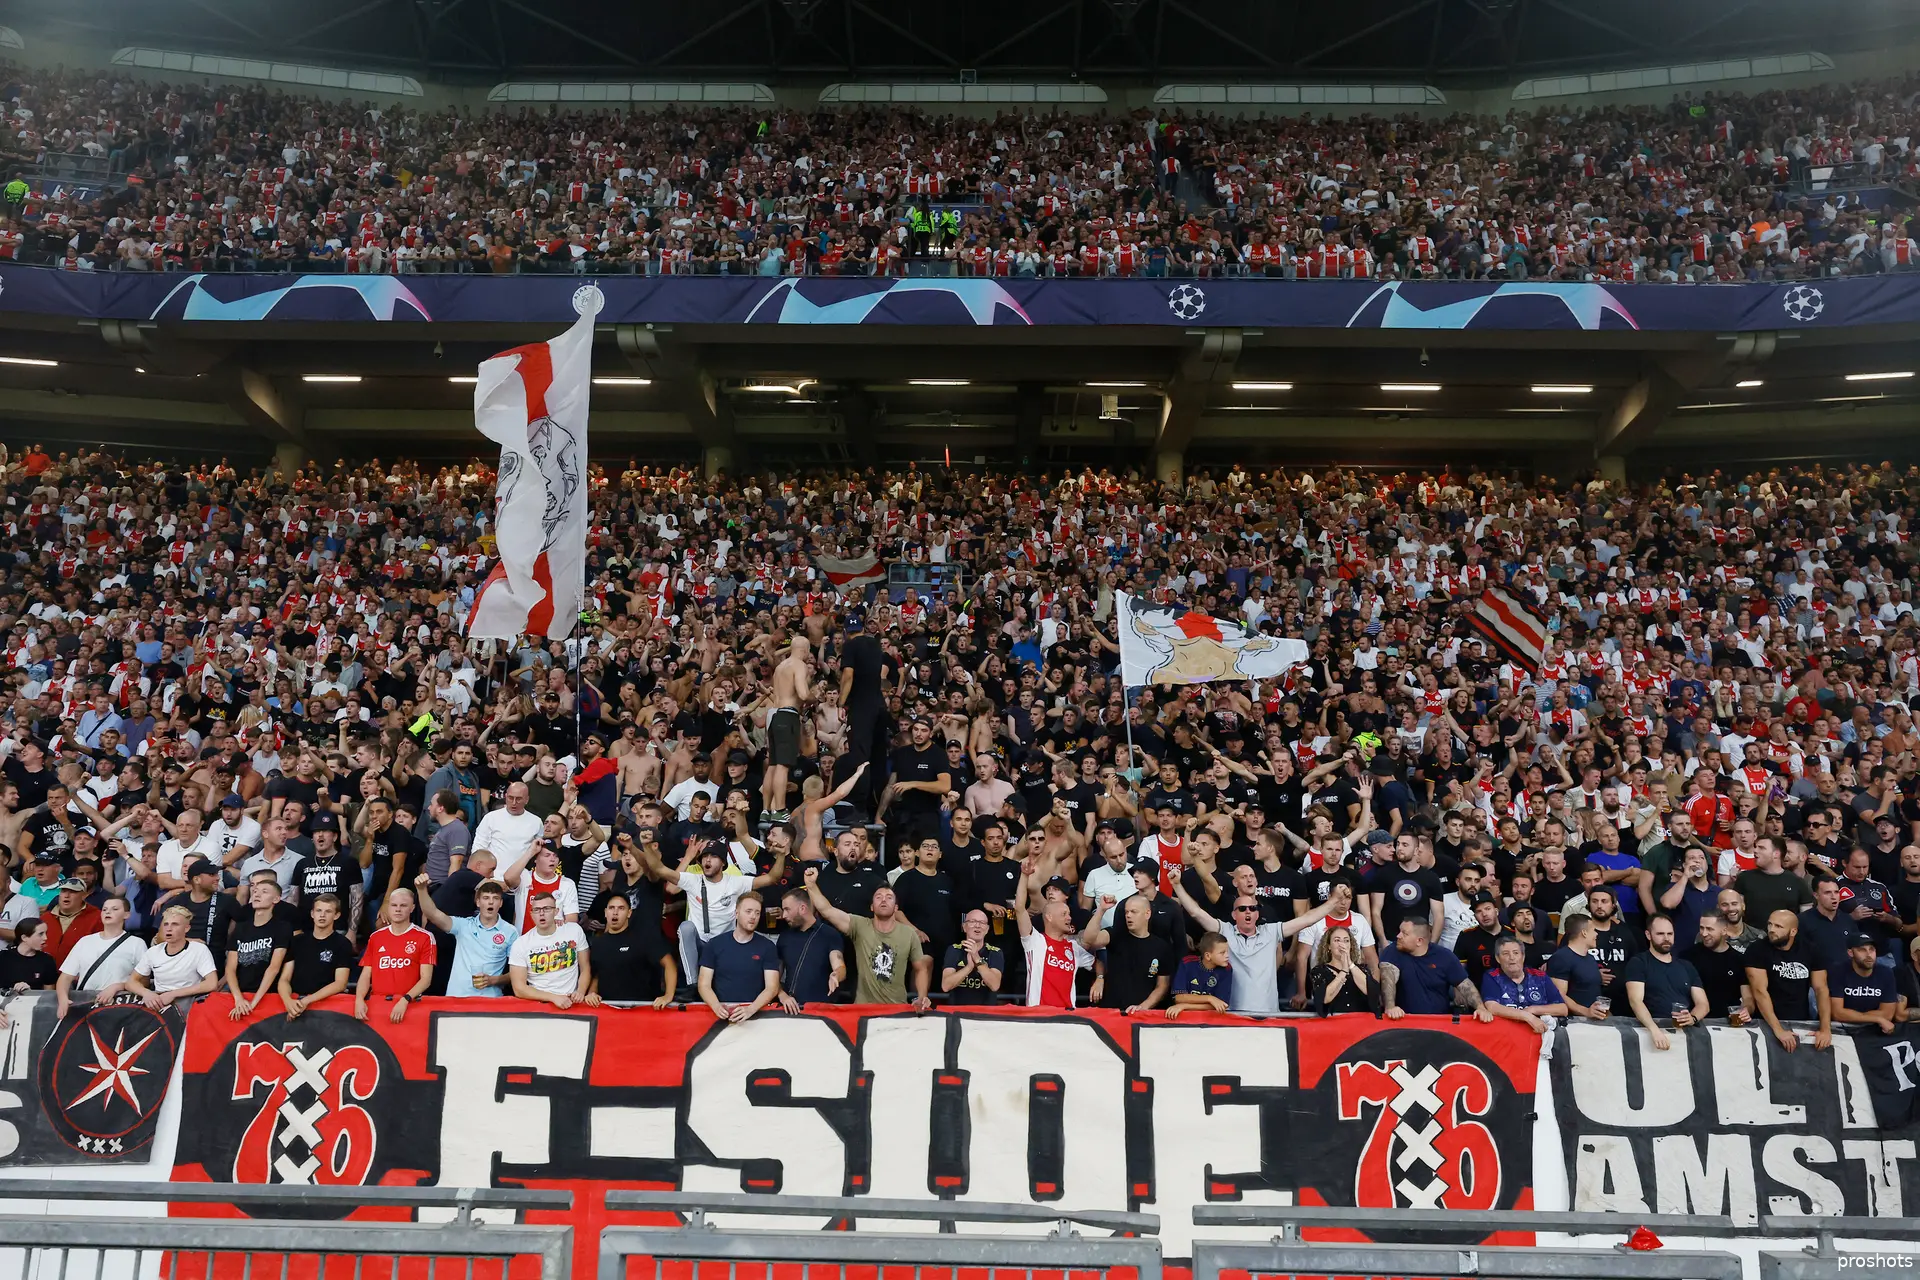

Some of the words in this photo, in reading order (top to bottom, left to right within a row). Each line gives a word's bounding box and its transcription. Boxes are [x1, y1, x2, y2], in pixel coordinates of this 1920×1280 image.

[379, 956, 411, 969] Ziggo
[1047, 954, 1074, 972] Ziggo
[1779, 970, 1797, 980] FACE
[1843, 986, 1882, 997] adidas
